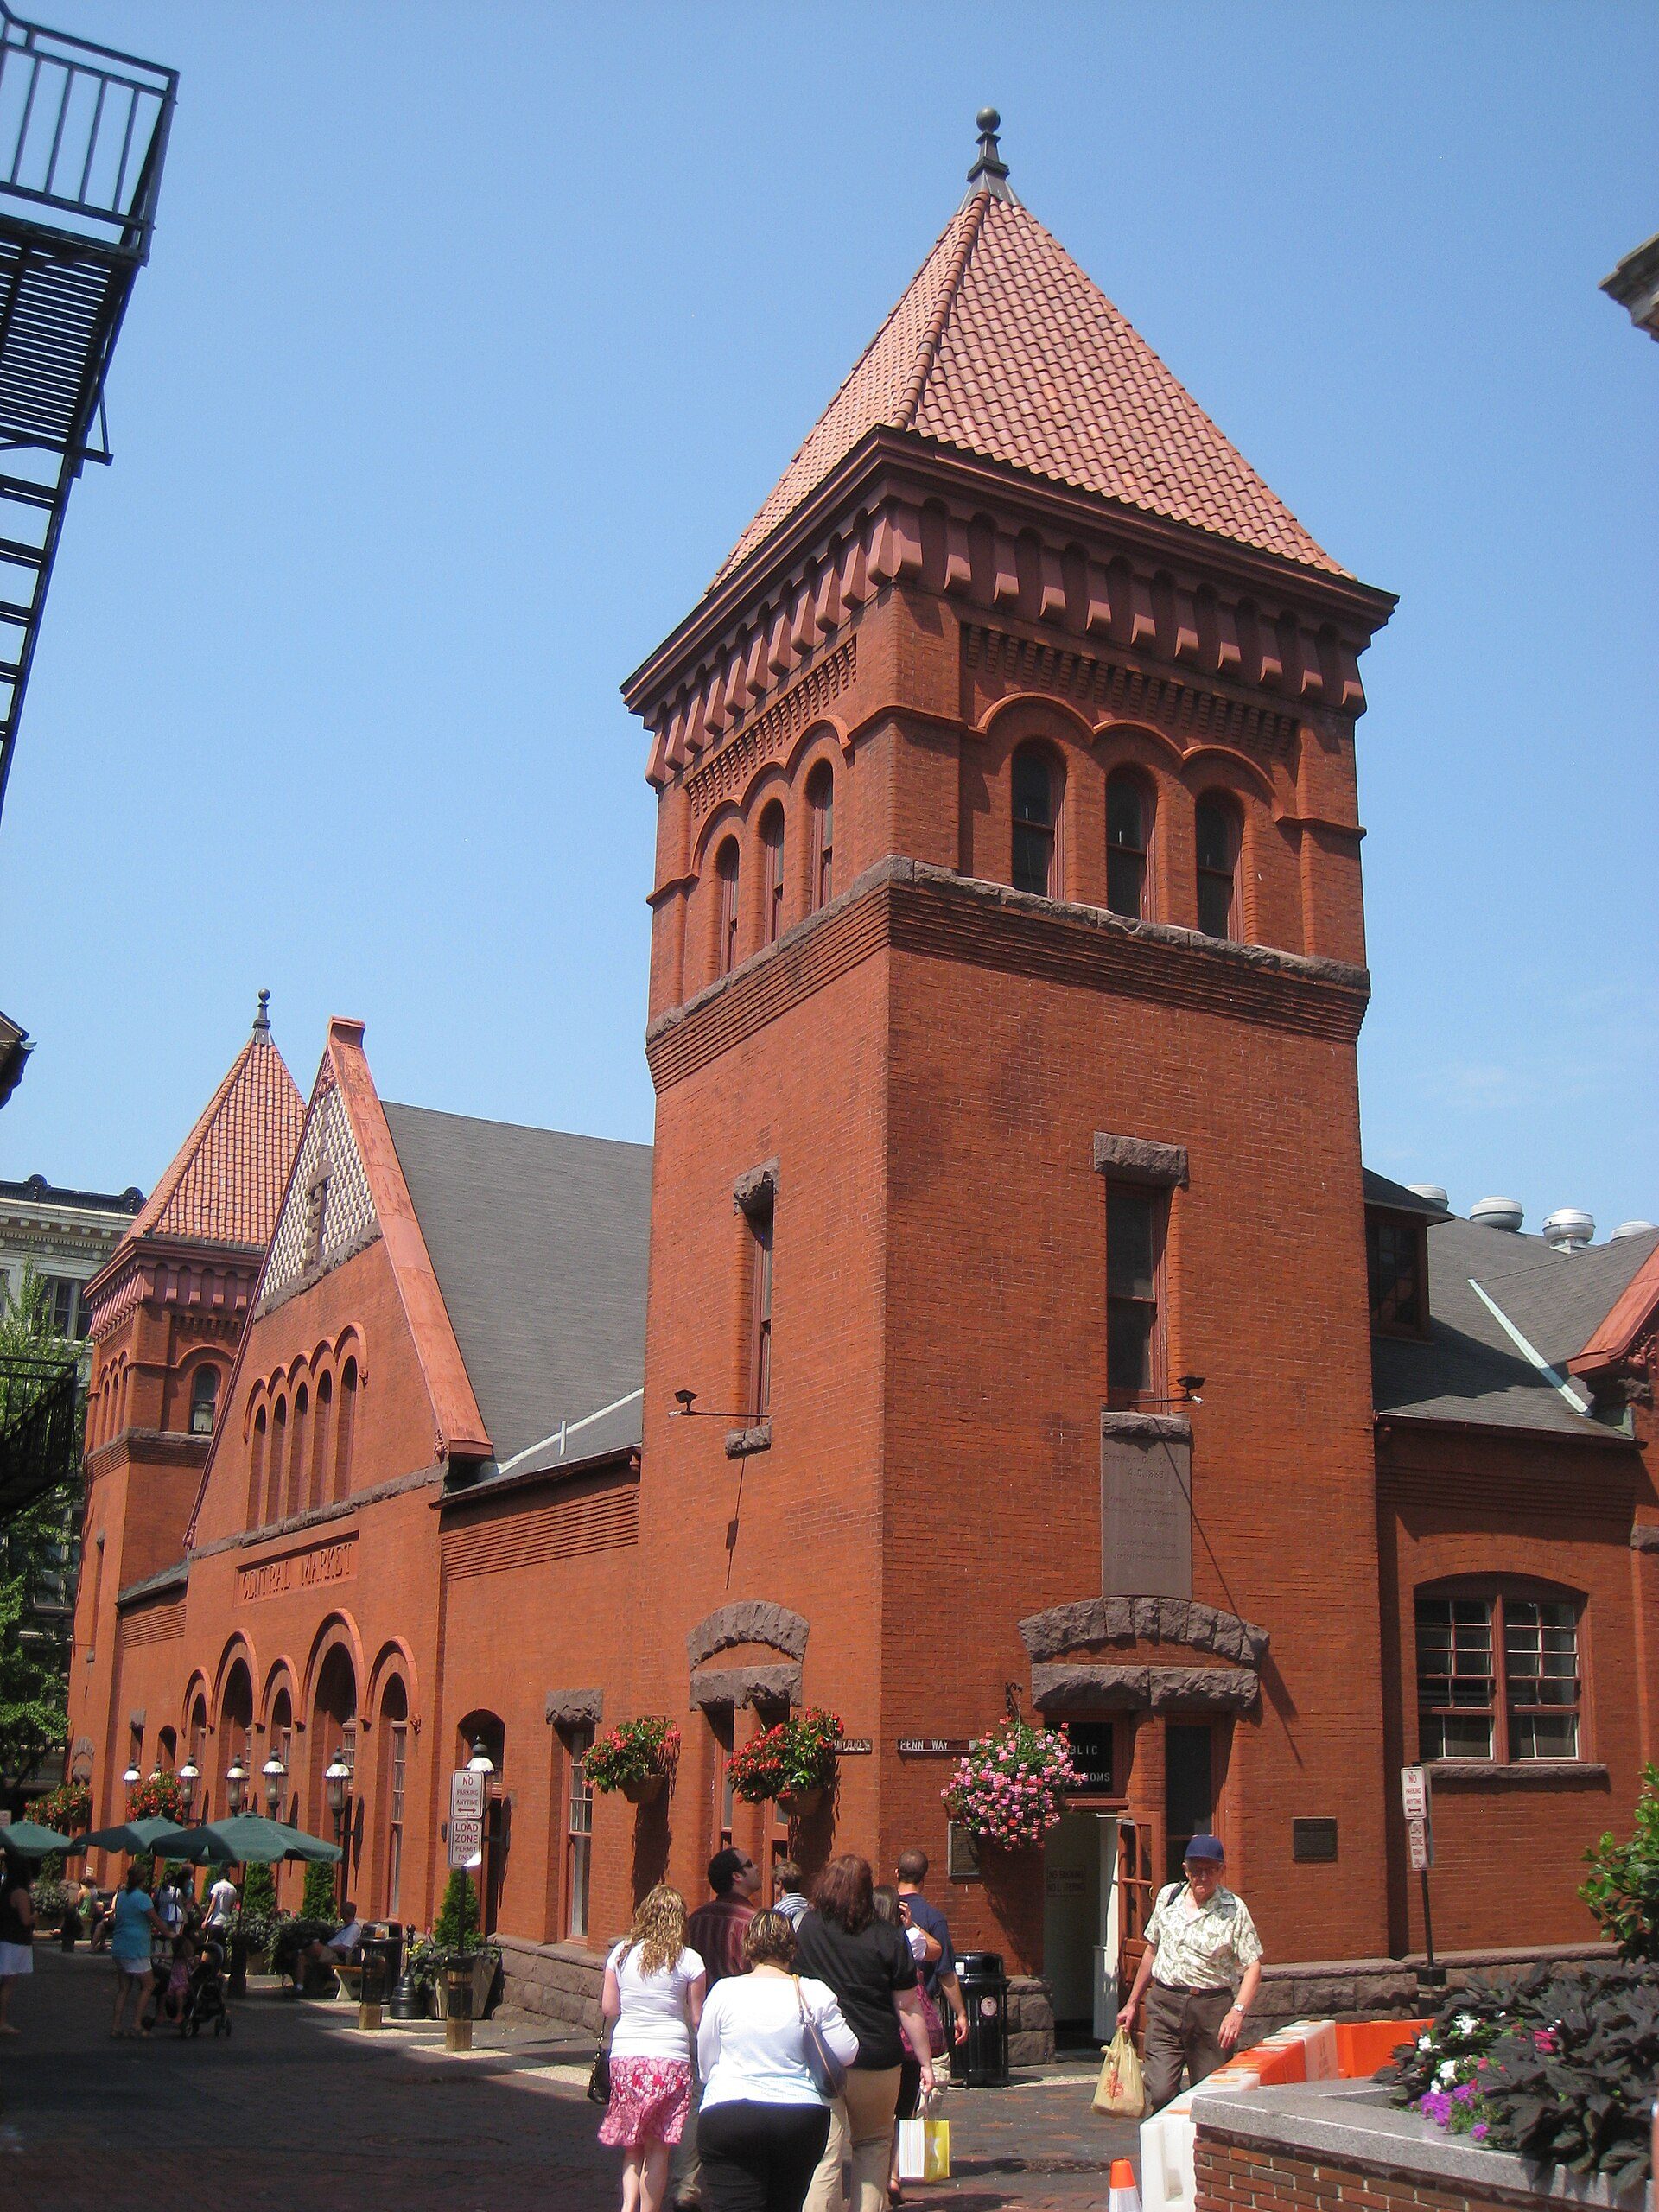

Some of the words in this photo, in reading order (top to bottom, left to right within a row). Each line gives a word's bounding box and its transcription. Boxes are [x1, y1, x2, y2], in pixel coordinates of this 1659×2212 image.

[242, 1560, 291, 1599] CENTRAL
[302, 1542, 354, 1586] MARKET
[900, 1739, 925, 1751] PENN
[931, 1739, 949, 1751] WAY
[1063, 1745, 1098, 1756] BLIC
[462, 1777, 474, 1786] NO
[1408, 1775, 1417, 1783] NO
[455, 1822, 479, 1833] LOAD
[454, 1834, 479, 1844] ZONE
